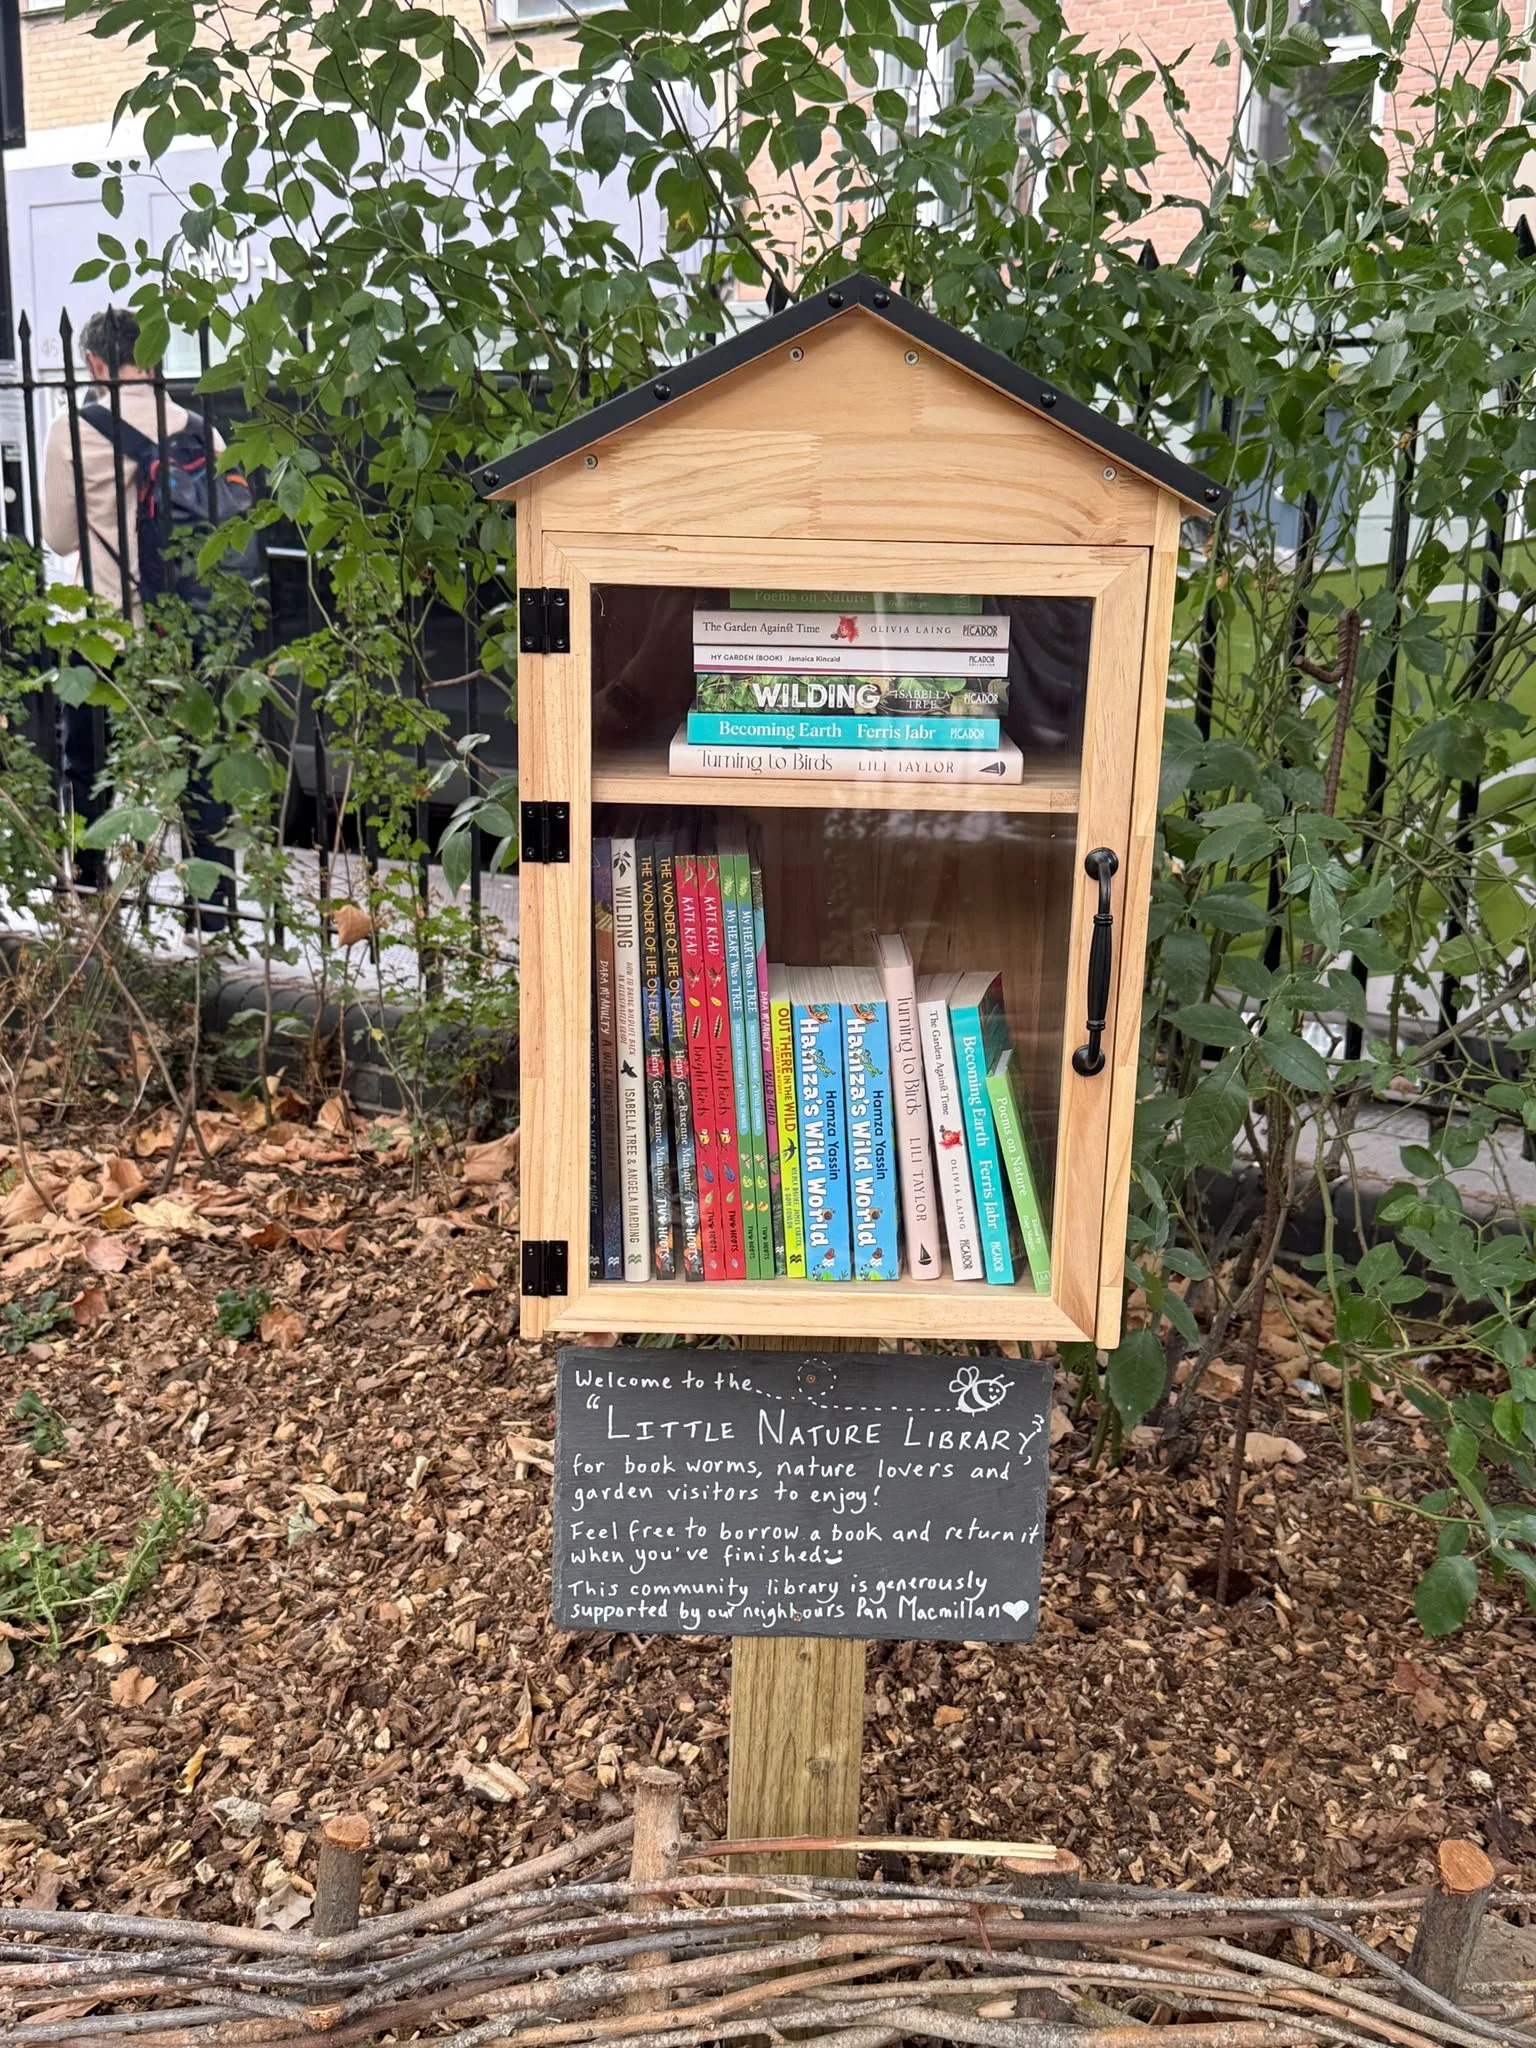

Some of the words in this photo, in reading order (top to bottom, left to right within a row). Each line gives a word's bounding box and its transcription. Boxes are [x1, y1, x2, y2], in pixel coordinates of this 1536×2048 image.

[801, 593, 817, 603] on
[703, 621, 722, 632] The
[723, 621, 757, 633] Garden
[760, 622, 794, 636] Against
[796, 623, 820, 634] Time
[870, 625, 910, 634] OLIVIA
[916, 626, 952, 635] LAING
[962, 624, 998, 637] PICADOR
[723, 654, 754, 662] GARDEN
[788, 655, 814, 663] Jamaica
[816, 655, 841, 663] Kincaid
[968, 655, 995, 663] PICADOR
[752, 683, 880, 709] WILDING
[894, 689, 950, 700] ISABELLA
[906, 699, 937, 710] TREE
[964, 692, 998, 704] PICADOR
[719, 720, 796, 741] Becoming
[800, 722, 842, 738] Earth
[857, 723, 901, 739] Ferris
[905, 724, 936, 741] Jabr
[950, 727, 985, 740] PICADOR
[698, 749, 763, 776] Turning
[769, 753, 787, 770] to
[793, 752, 833, 771] Birds
[858, 760, 887, 772] LILI
[899, 760, 954, 774] TAYLOR
[641, 856, 652, 877] THE
[660, 857, 672, 878] THE
[615, 885, 633, 948] WILDING
[641, 880, 655, 934] WONDER
[662, 881, 676, 935] WONDER
[681, 896, 695, 924] KATE
[703, 896, 717, 924] KATE
[644, 936, 656, 955] OF
[665, 937, 678, 956] OF
[684, 926, 698, 956] READ
[706, 926, 720, 956] READ
[727, 925, 740, 959] HEART
[742, 926, 754, 960] HEART
[645, 956, 657, 976] LIFE
[667, 957, 679, 977] LIFE
[646, 978, 658, 998] ON
[668, 979, 680, 1000] ON
[731, 985, 743, 1012] TREE
[746, 986, 757, 1013] TREE
[759, 991, 769, 1011] DARA
[648, 1001, 660, 1036] EARTH
[670, 1002, 683, 1038] EARTH
[778, 1008, 791, 1033] OUT
[895, 991, 915, 1053] Turning
[929, 1010, 938, 1028] The
[779, 1035, 793, 1074] THERE
[932, 1029, 943, 1060] Garden
[650, 1049, 661, 1077] Henry
[673, 1050, 684, 1079] Henry
[800, 1018, 823, 1117] Hamza's
[846, 1018, 870, 1117] Hamza's
[902, 1057, 916, 1075] to
[962, 1035, 983, 1106] Becoming
[652, 1080, 663, 1099] Gee
[677, 1081, 687, 1100] Gee
[765, 1069, 774, 1095] WILD
[782, 1075, 791, 1084] IN
[783, 1086, 793, 1100] THE
[624, 1088, 636, 1131] ISABELLA
[766, 1098, 776, 1126] CHILD
[904, 1079, 922, 1116] Birds
[940, 1093, 950, 1116] Time
[653, 1103, 663, 1143] Raxenne
[678, 1105, 689, 1145] Raxenne
[783, 1102, 796, 1132] WILD
[825, 1090, 838, 1137] Hamza
[872, 1090, 885, 1137] Hamza
[972, 1107, 990, 1147] Earth
[996, 1096, 1013, 1139] Poems
[626, 1134, 637, 1156] TREE
[804, 1120, 826, 1172] Wild
[851, 1120, 873, 1172] Wild
[909, 1137, 922, 1163] LILI
[1006, 1139, 1017, 1153] on
[654, 1146, 665, 1189] Maniquiz
[681, 1147, 692, 1191] Maniquiz
[827, 1141, 841, 1180] Yassin
[875, 1140, 888, 1180] Yassin
[627, 1168, 639, 1202] ANGELA
[950, 1159, 961, 1194] OLIVIA
[979, 1160, 994, 1199] Ferris
[1011, 1155, 1028, 1197] Nature
[912, 1171, 928, 1222] TAYLOR
[628, 1205, 640, 1243] HARDING
[807, 1176, 830, 1247] World
[854, 1176, 877, 1247] World
[955, 1198, 967, 1230] LAING
[984, 1201, 999, 1229] Jabr
[959, 1239, 974, 1271] PICADOR
[991, 1241, 1004, 1273] PICADOR
[575, 1369, 673, 1389] Welcome
[681, 1369, 705, 1389] to
[714, 1371, 753, 1391] the
[758, 1408, 882, 1447] NATURE
[573, 1453, 605, 1476] for
[624, 1454, 676, 1475] book
[686, 1458, 764, 1479] worms,
[776, 1455, 857, 1477] nature
[878, 1458, 954, 1479] lovers
[970, 1461, 1011, 1481] and
[571, 1482, 653, 1512] garden
[667, 1481, 759, 1501] visitors
[774, 1480, 799, 1501] to
[810, 1484, 881, 1515] enjoy!
[570, 1520, 618, 1541] Feel
[629, 1519, 676, 1542] free
[685, 1516, 707, 1539] to
[720, 1521, 799, 1541] borrow
[809, 1529, 822, 1542] a
[832, 1521, 883, 1542] book
[892, 1520, 931, 1543] and
[945, 1517, 1015, 1541] return
[1020, 1523, 1040, 1545] it
[571, 1546, 624, 1564] when
[629, 1546, 709, 1575] you've
[723, 1544, 822, 1567] finished
[567, 1580, 619, 1597] This
[630, 1577, 749, 1607] community
[767, 1578, 839, 1604] library
[851, 1573, 868, 1593] is
[869, 1570, 988, 1605] generously
[570, 1599, 669, 1625] supported
[679, 1601, 701, 1631] by
[707, 1606, 735, 1620] our
[857, 1596, 888, 1620] Pan
[898, 1594, 1001, 1622] Macmillan
